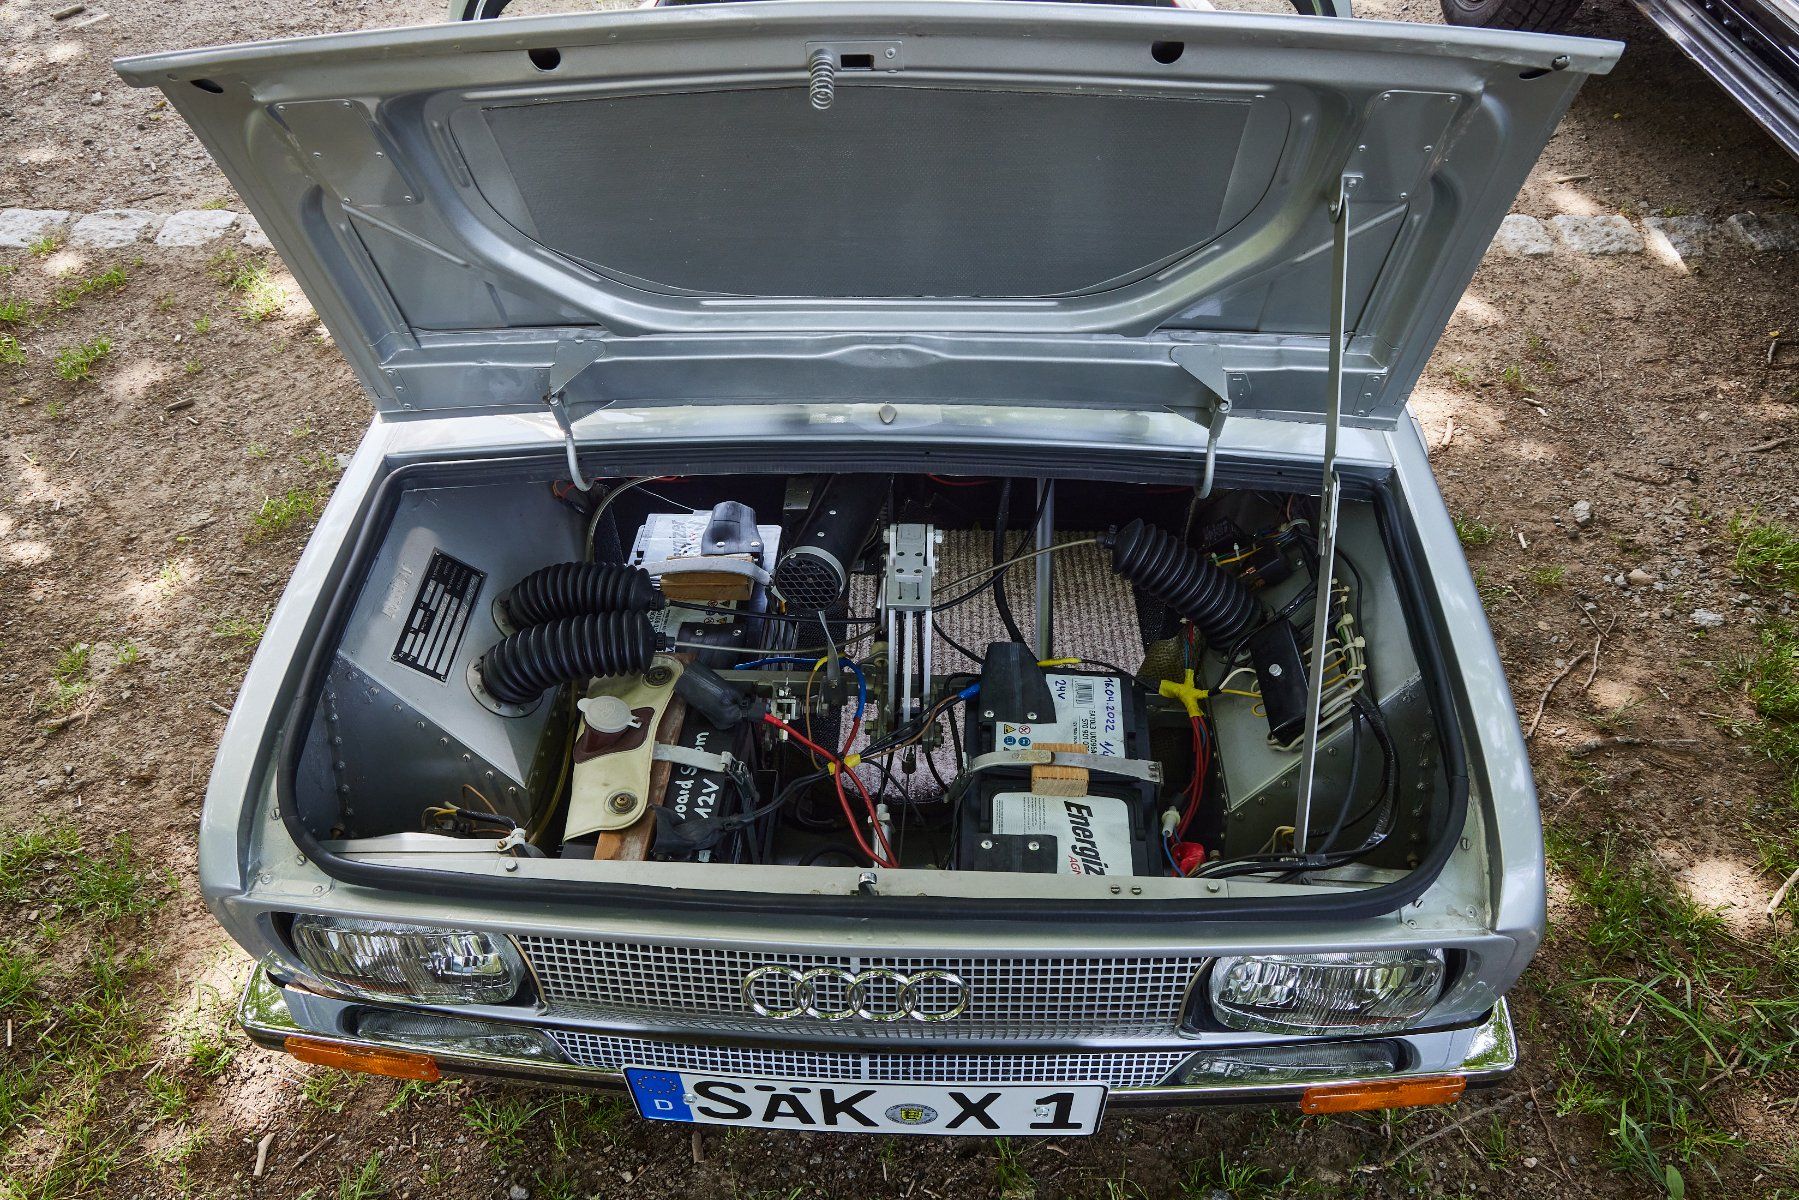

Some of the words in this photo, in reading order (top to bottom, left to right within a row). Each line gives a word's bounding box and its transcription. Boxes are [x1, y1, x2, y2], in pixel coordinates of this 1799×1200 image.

[1104, 677, 1115, 733] 16.04.2022
[694, 778, 719, 819] 12V
[1064, 801, 1109, 875] Energiz
[654, 1099, 673, 1110] D
[693, 1080, 880, 1127] SÄK
[945, 1091, 1002, 1129] X
[1029, 1092, 1083, 1130] 1
